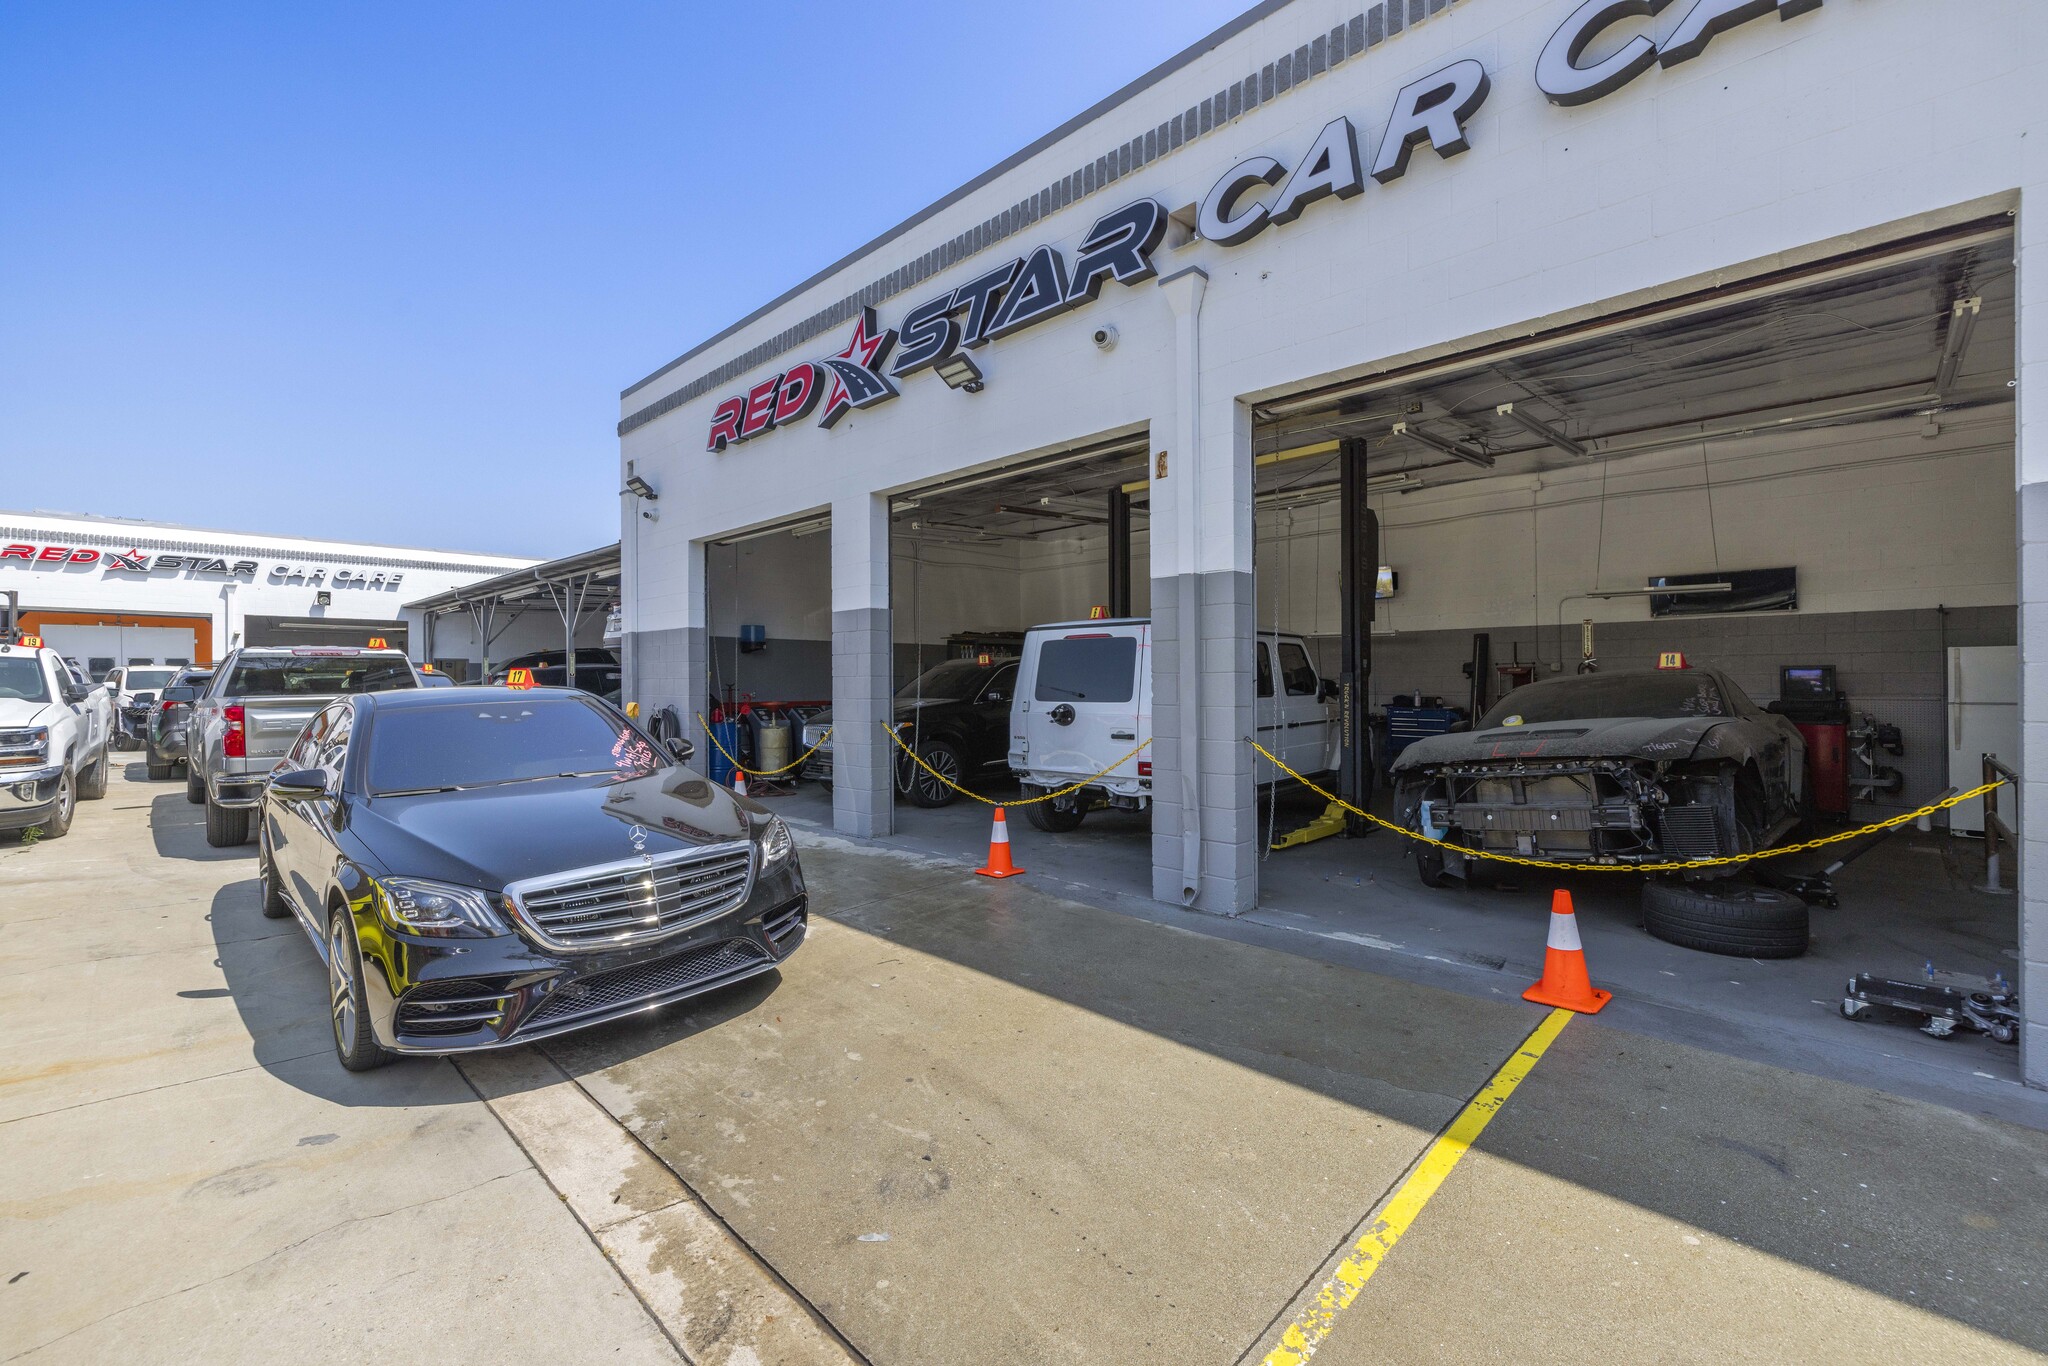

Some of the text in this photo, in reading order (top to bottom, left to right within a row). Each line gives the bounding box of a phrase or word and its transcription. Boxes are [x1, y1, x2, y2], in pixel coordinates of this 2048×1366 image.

[707, 58, 1491, 453] RED STAR CAR
[0, 544, 405, 583] RED STAR CAR CARE
[1665, 654, 1676, 666] 14
[512, 671, 523, 683] 17
